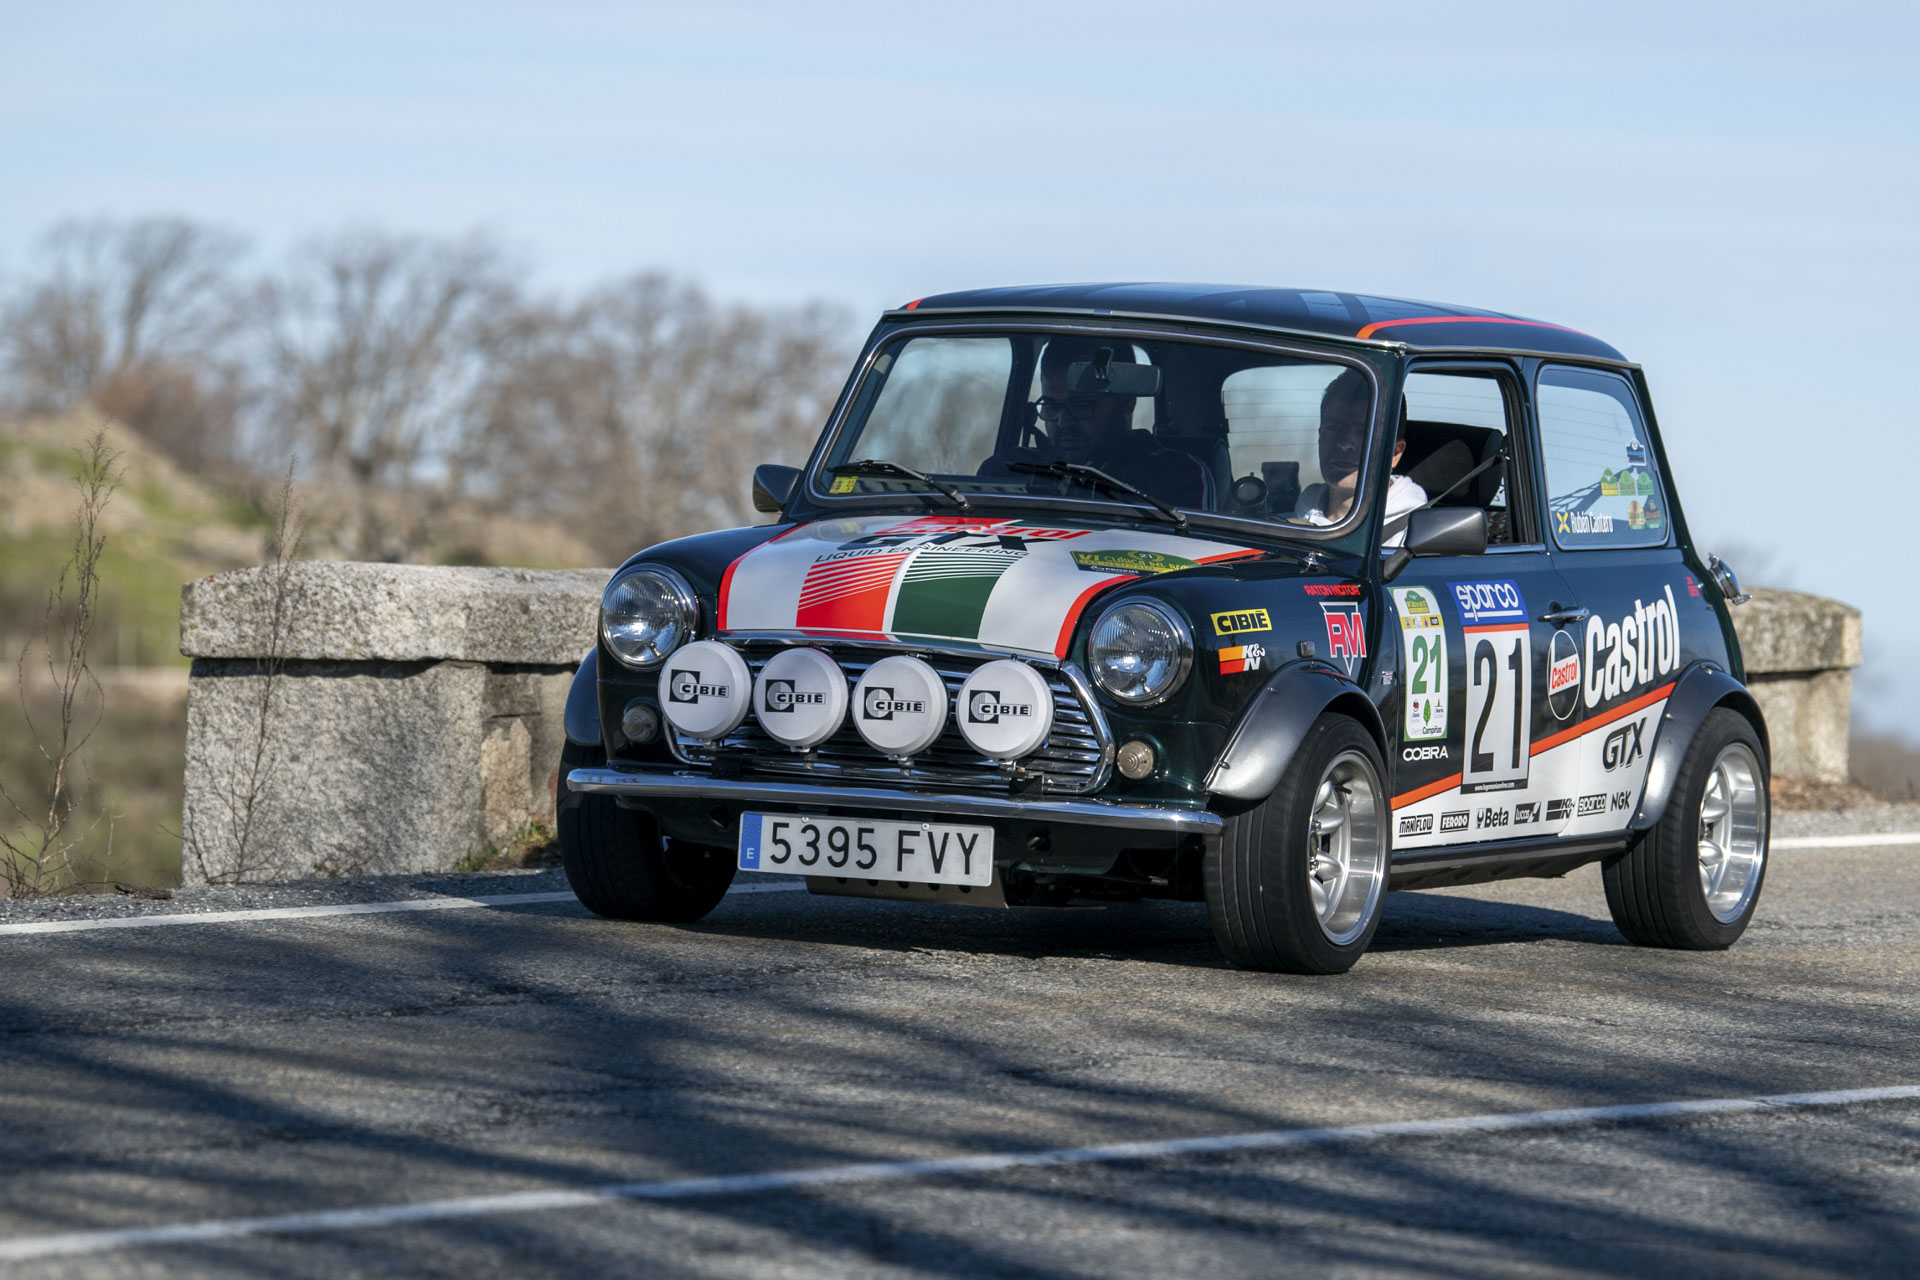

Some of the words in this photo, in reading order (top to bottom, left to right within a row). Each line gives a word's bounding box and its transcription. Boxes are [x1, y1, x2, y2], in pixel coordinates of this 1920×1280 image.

[815, 547, 881, 562] LIQUID
[886, 543, 1029, 557] ENGINEERING
[1456, 583, 1520, 621] sparco
[1583, 584, 1681, 708] Castrol
[1411, 634, 1441, 694] 21
[1551, 658, 1578, 689] Castrol
[1470, 637, 1522, 773] 21
[1403, 745, 1449, 761] COBRA
[1602, 717, 1648, 772] GTX
[1578, 795, 1607, 813] sparco
[1611, 790, 1632, 811] NGK
[1442, 814, 1468, 829] FERODO
[1484, 807, 1509, 828] Beta
[746, 847, 755, 860] E
[769, 822, 878, 870] 5395
[896, 829, 979, 875] FVY
